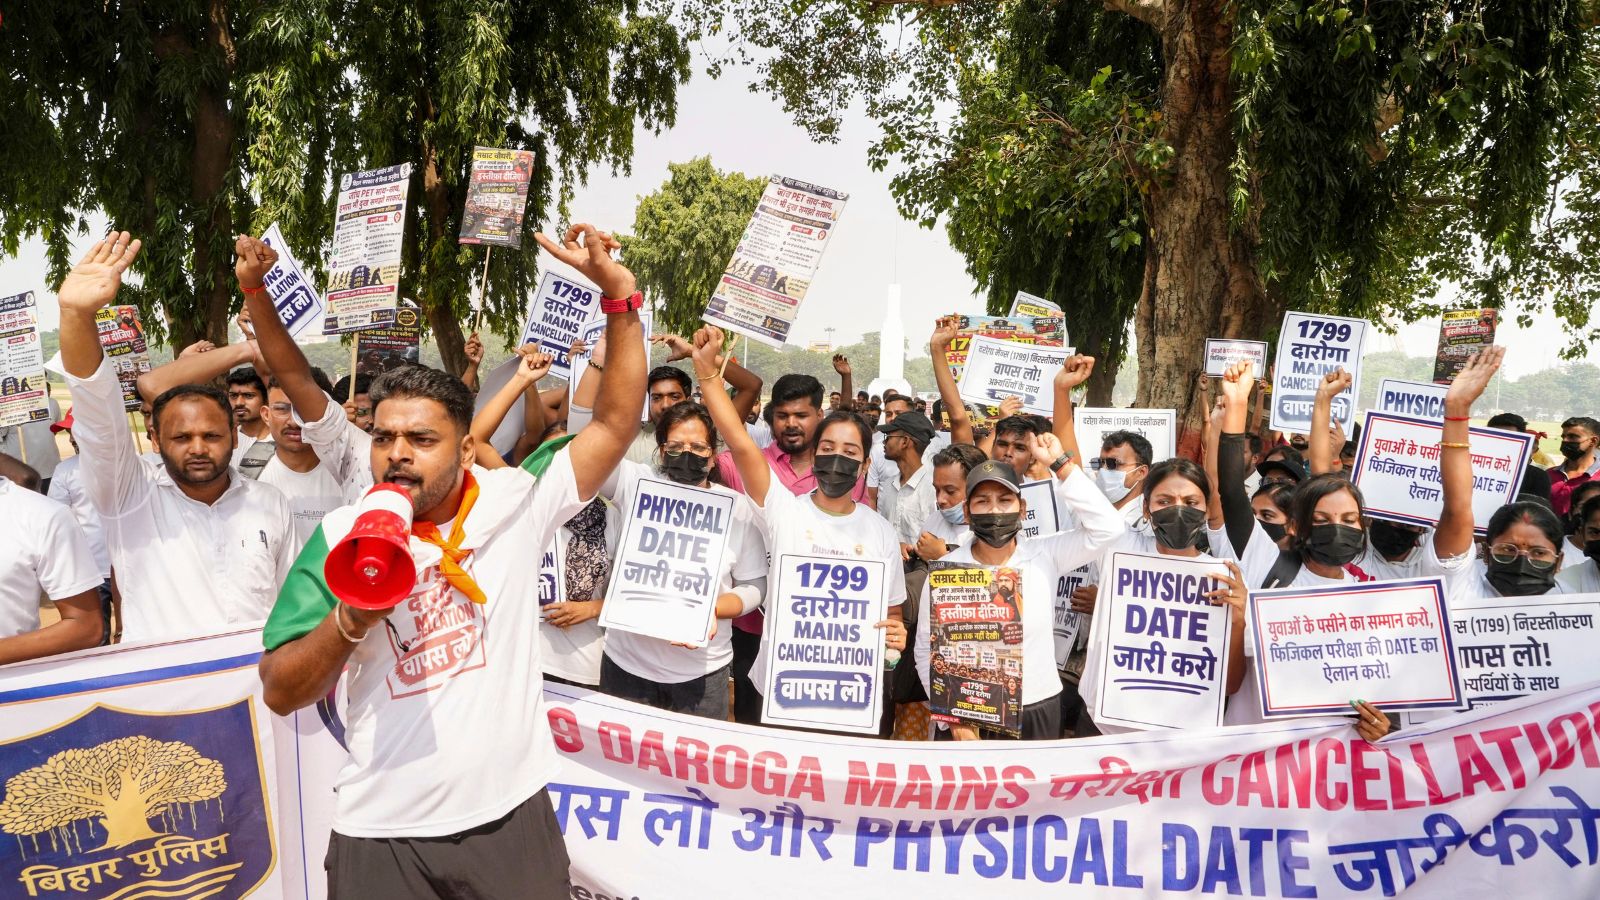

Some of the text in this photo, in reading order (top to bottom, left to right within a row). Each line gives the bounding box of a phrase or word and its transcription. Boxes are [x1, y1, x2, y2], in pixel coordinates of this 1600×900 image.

[361, 188, 375, 197] PET
[777, 188, 792, 198] जांच
[792, 191, 806, 202] PET
[264, 266, 284, 287] INS
[291, 289, 310, 310] लो
[552, 281, 593, 306] 1799
[544, 296, 588, 322] दारोगा
[530, 322, 578, 346] CANCELLATI
[542, 312, 580, 333] MAINS
[1298, 320, 1352, 342] 1799
[1010, 350, 1030, 363] (1799)
[1291, 340, 1350, 362] दारोगा
[994, 362, 1042, 382] वापस लो!
[1018, 381, 1024, 391] के
[1025, 384, 1040, 394] साथ
[1384, 391, 1446, 418] PHYSICA
[1114, 416, 1132, 427] (1799)
[1374, 438, 1512, 473] युवाओं के पसी म्मान करो,
[1368, 456, 1417, 479] फिजिकल
[1495, 480, 1509, 495] का
[1409, 481, 1441, 502] ऐलान
[636, 493, 723, 535] PHYSICAL
[638, 526, 710, 564] DATE
[624, 559, 712, 596] जारी करो
[796, 562, 868, 592] 1799
[933, 571, 988, 585] सम्राट चौधरी,
[1117, 568, 1223, 607] PHYSICAL
[791, 590, 870, 620] दारोगा
[794, 621, 861, 642] MAINS
[950, 632, 962, 640] आज
[974, 630, 985, 640] नहीं
[1125, 604, 1209, 643] DATE
[1267, 606, 1434, 642] युवाओं के पसीने का सम्मान करो,
[1471, 611, 1593, 636] (1799) निरस्तीकरण
[402, 629, 478, 676] वापस लो
[778, 643, 874, 667] CANCELLATION
[1113, 640, 1218, 681] जारी करो
[1270, 636, 1439, 662] फिजिकल परीक्षा की DATE का
[1458, 636, 1552, 669] ापस लो!
[1323, 659, 1391, 684] ऐलान करो!
[1512, 673, 1525, 691] के
[1528, 676, 1560, 691] साथ
[781, 674, 867, 703] वापस लो
[961, 687, 975, 696] बिहार
[967, 681, 984, 691] 1799
[957, 701, 973, 711] सफल
[598, 720, 825, 802] DAROGA
[843, 759, 1036, 811] MAINS
[643, 786, 720, 849] लो
[732, 801, 842, 862] और
[853, 815, 1143, 888] PHYSICAL
[1162, 823, 1317, 899] DATE
[1468, 786, 1600, 869] करो
[18, 832, 231, 897] बिहार पुलिस
